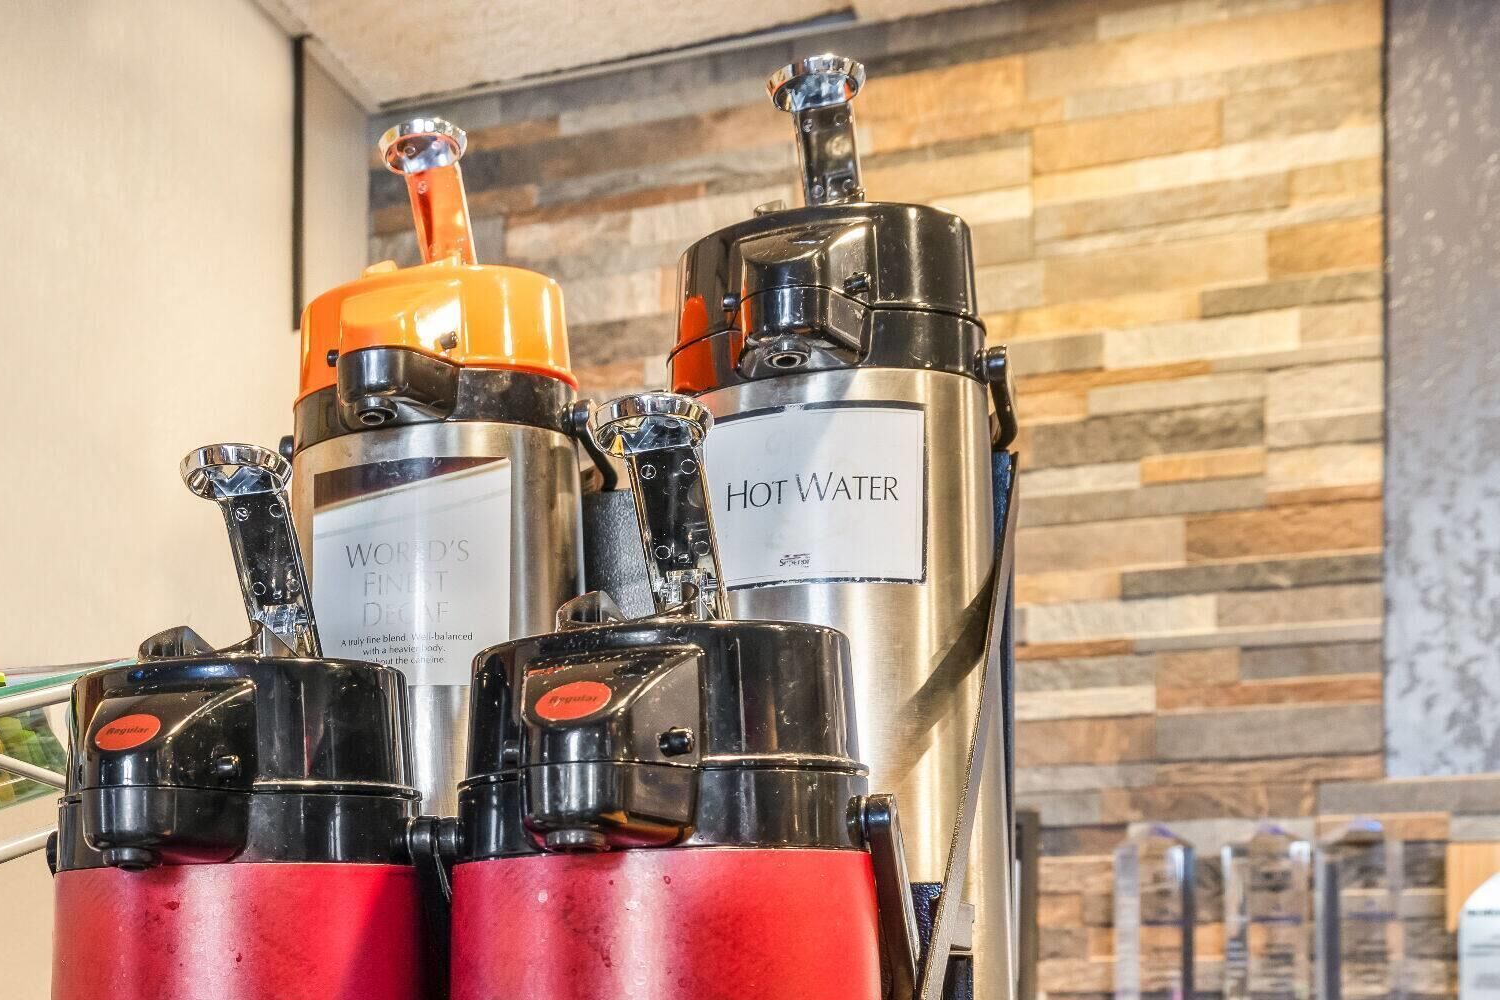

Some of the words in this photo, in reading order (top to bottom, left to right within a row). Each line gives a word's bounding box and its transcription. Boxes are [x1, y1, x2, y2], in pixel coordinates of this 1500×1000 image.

[727, 479, 788, 512] HOT
[796, 471, 900, 503] WATER
[345, 539, 470, 569] WORD'S
[366, 634, 381, 645] fine
[106, 726, 150, 736] Regular
